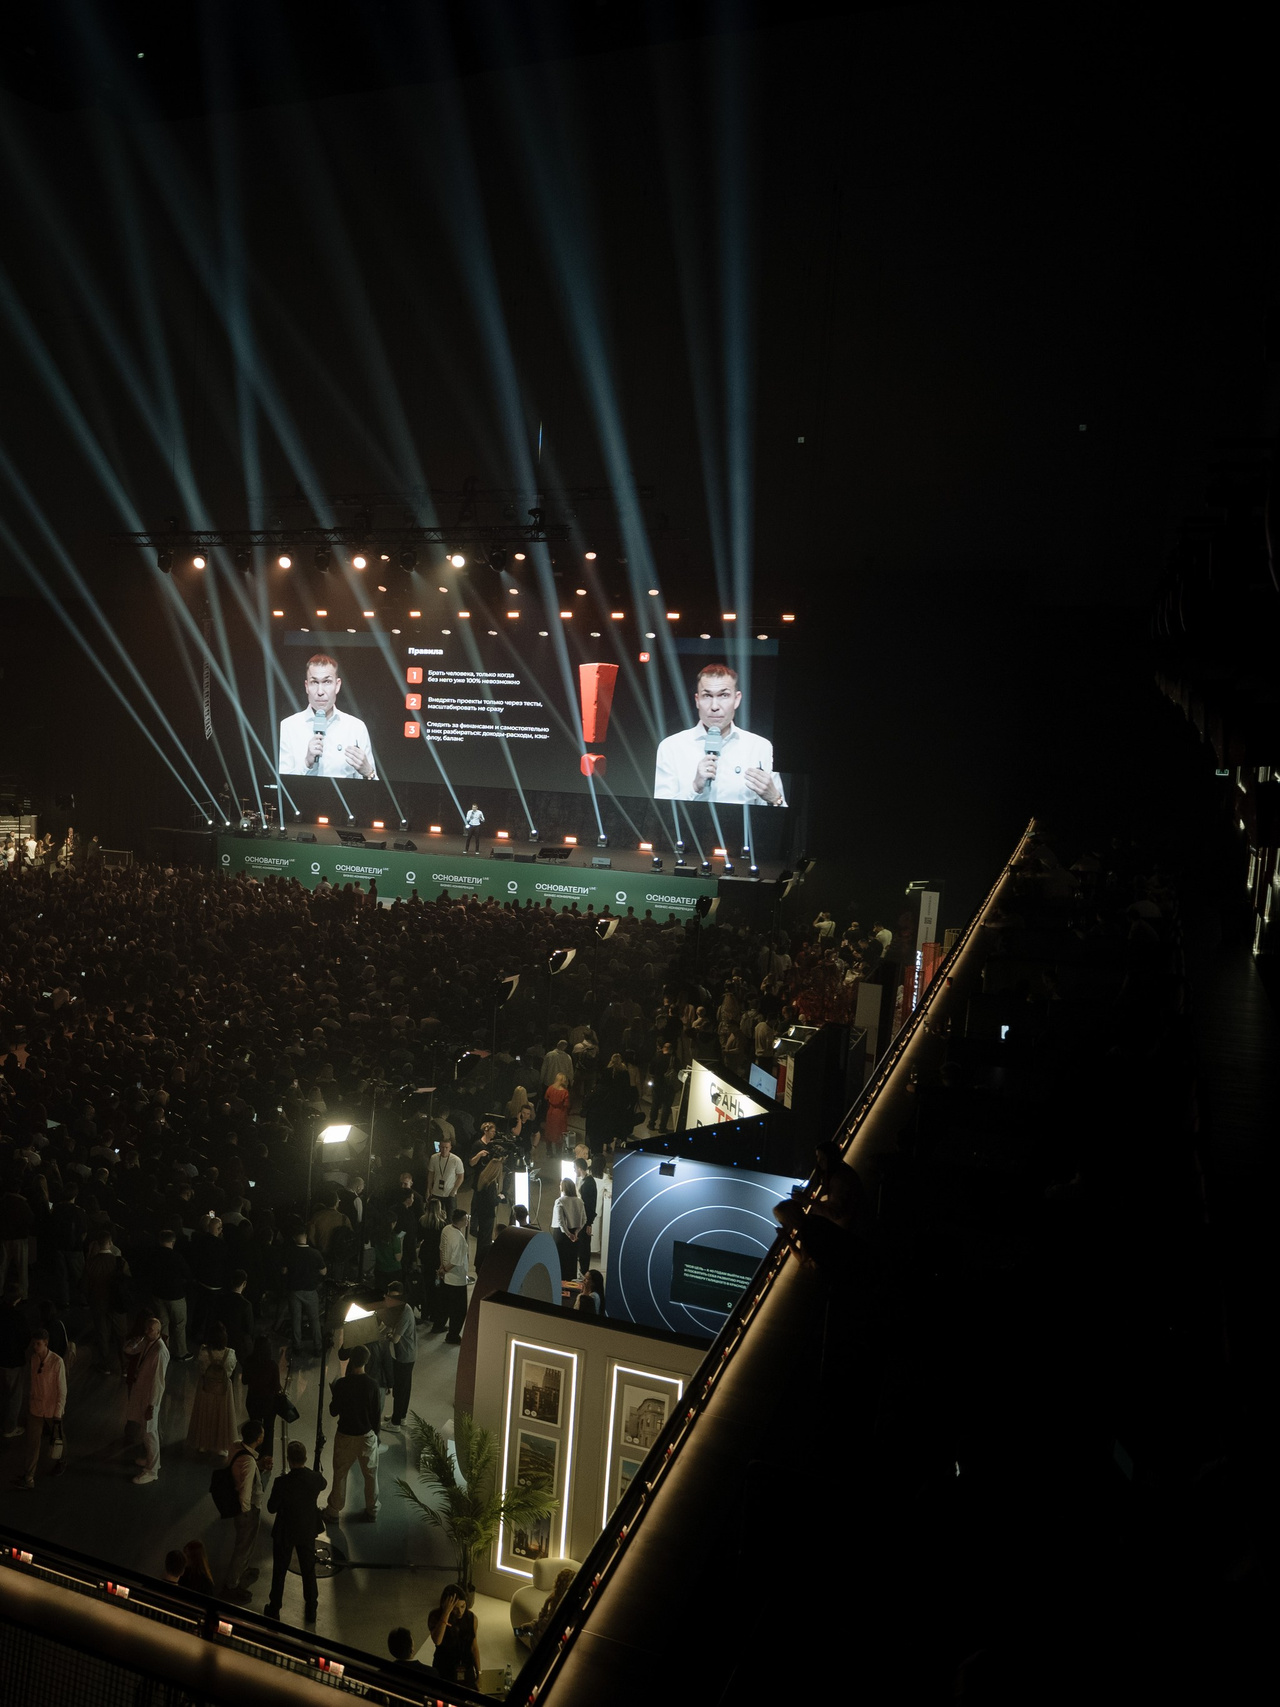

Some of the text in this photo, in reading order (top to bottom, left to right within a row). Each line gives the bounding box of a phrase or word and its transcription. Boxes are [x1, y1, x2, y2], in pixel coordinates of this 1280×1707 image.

[408, 647, 444, 656] Правила
[412, 671, 417, 680] 1
[410, 698, 417, 706] 2
[428, 704, 477, 712] масштабировать
[408, 726, 416, 734] 3
[426, 721, 452, 729] Следить
[460, 723, 494, 731] финансами
[500, 725, 550, 733] самостоятельно
[482, 732, 534, 740] доходы-расходы,
[244, 856, 290, 866] ОСНОВАТЕЛИ
[336, 864, 382, 875] ОСНОВАТЕЛИ
[432, 873, 482, 884] ОСНОВАТЕЛИ
[535, 882, 589, 894] ОСНОВАТЕЛИ
[646, 894, 696, 905] ОСНОВАТЕЛ
